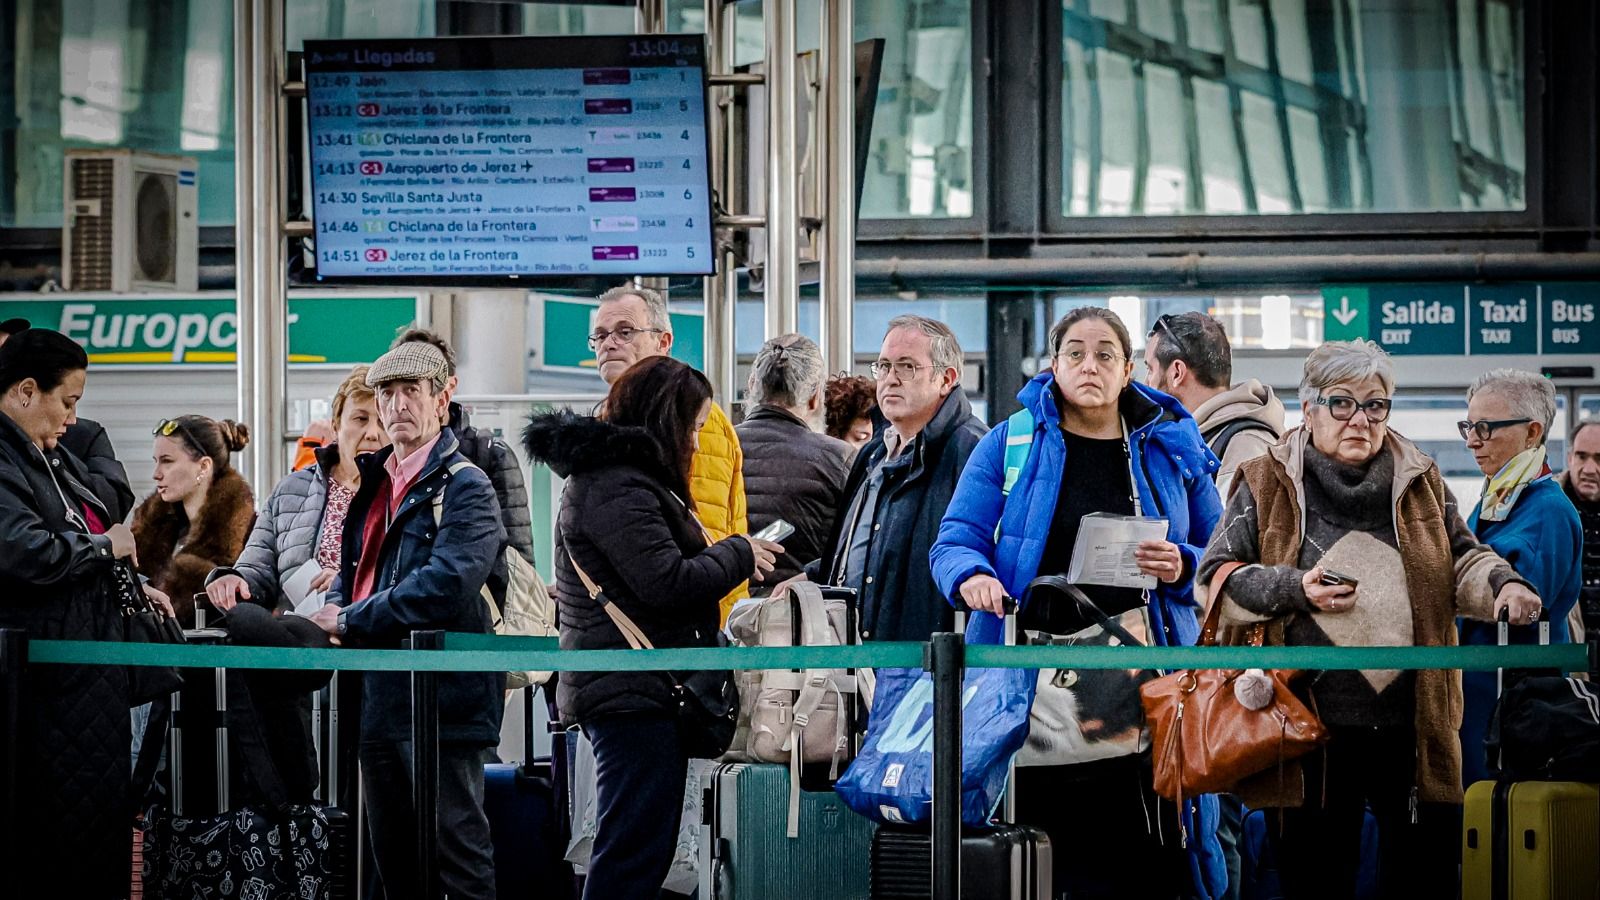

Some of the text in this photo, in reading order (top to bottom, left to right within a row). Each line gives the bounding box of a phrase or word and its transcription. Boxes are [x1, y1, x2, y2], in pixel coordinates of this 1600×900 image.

[629, 41, 680, 56] 13:04
[354, 48, 435, 67] Llegadas
[313, 75, 350, 88] 12:49
[315, 104, 352, 117] 13:12
[383, 105, 417, 116] Jerez
[422, 104, 438, 116] de
[441, 104, 453, 115] la
[456, 103, 511, 115] Frontera
[680, 101, 688, 112] 5
[317, 133, 352, 146] 13:41
[384, 132, 439, 145] Chiclana
[443, 133, 458, 144] de
[463, 133, 474, 144] la
[477, 132, 532, 144] Frontera
[681, 130, 690, 141] 4
[319, 162, 355, 175] 14:13
[385, 162, 458, 177] Aeropuerto
[462, 162, 478, 173] de
[481, 161, 516, 173] Jerez
[683, 158, 691, 170] 4
[320, 191, 483, 204] 14:30 Sevilla Santa Justa
[684, 188, 692, 201] 6
[321, 221, 358, 233] 14:46
[388, 220, 444, 233] Chiclana
[447, 220, 463, 232] de
[467, 220, 478, 231] la
[482, 219, 537, 231] Frontera
[685, 217, 693, 228] 4
[323, 250, 359, 262] 14:51
[390, 249, 426, 262] Jerez
[429, 249, 445, 261] de
[449, 249, 460, 261] la
[464, 248, 519, 261] Frontera
[687, 246, 695, 259] 5
[1381, 299, 1455, 324] Salida
[1480, 298, 1527, 324] Taxi
[1552, 299, 1594, 323] Bus
[59, 303, 298, 363] Europc
[1381, 329, 1411, 345] EXIT
[1481, 328, 1511, 344] TAXI
[1552, 328, 1580, 344] BUS
